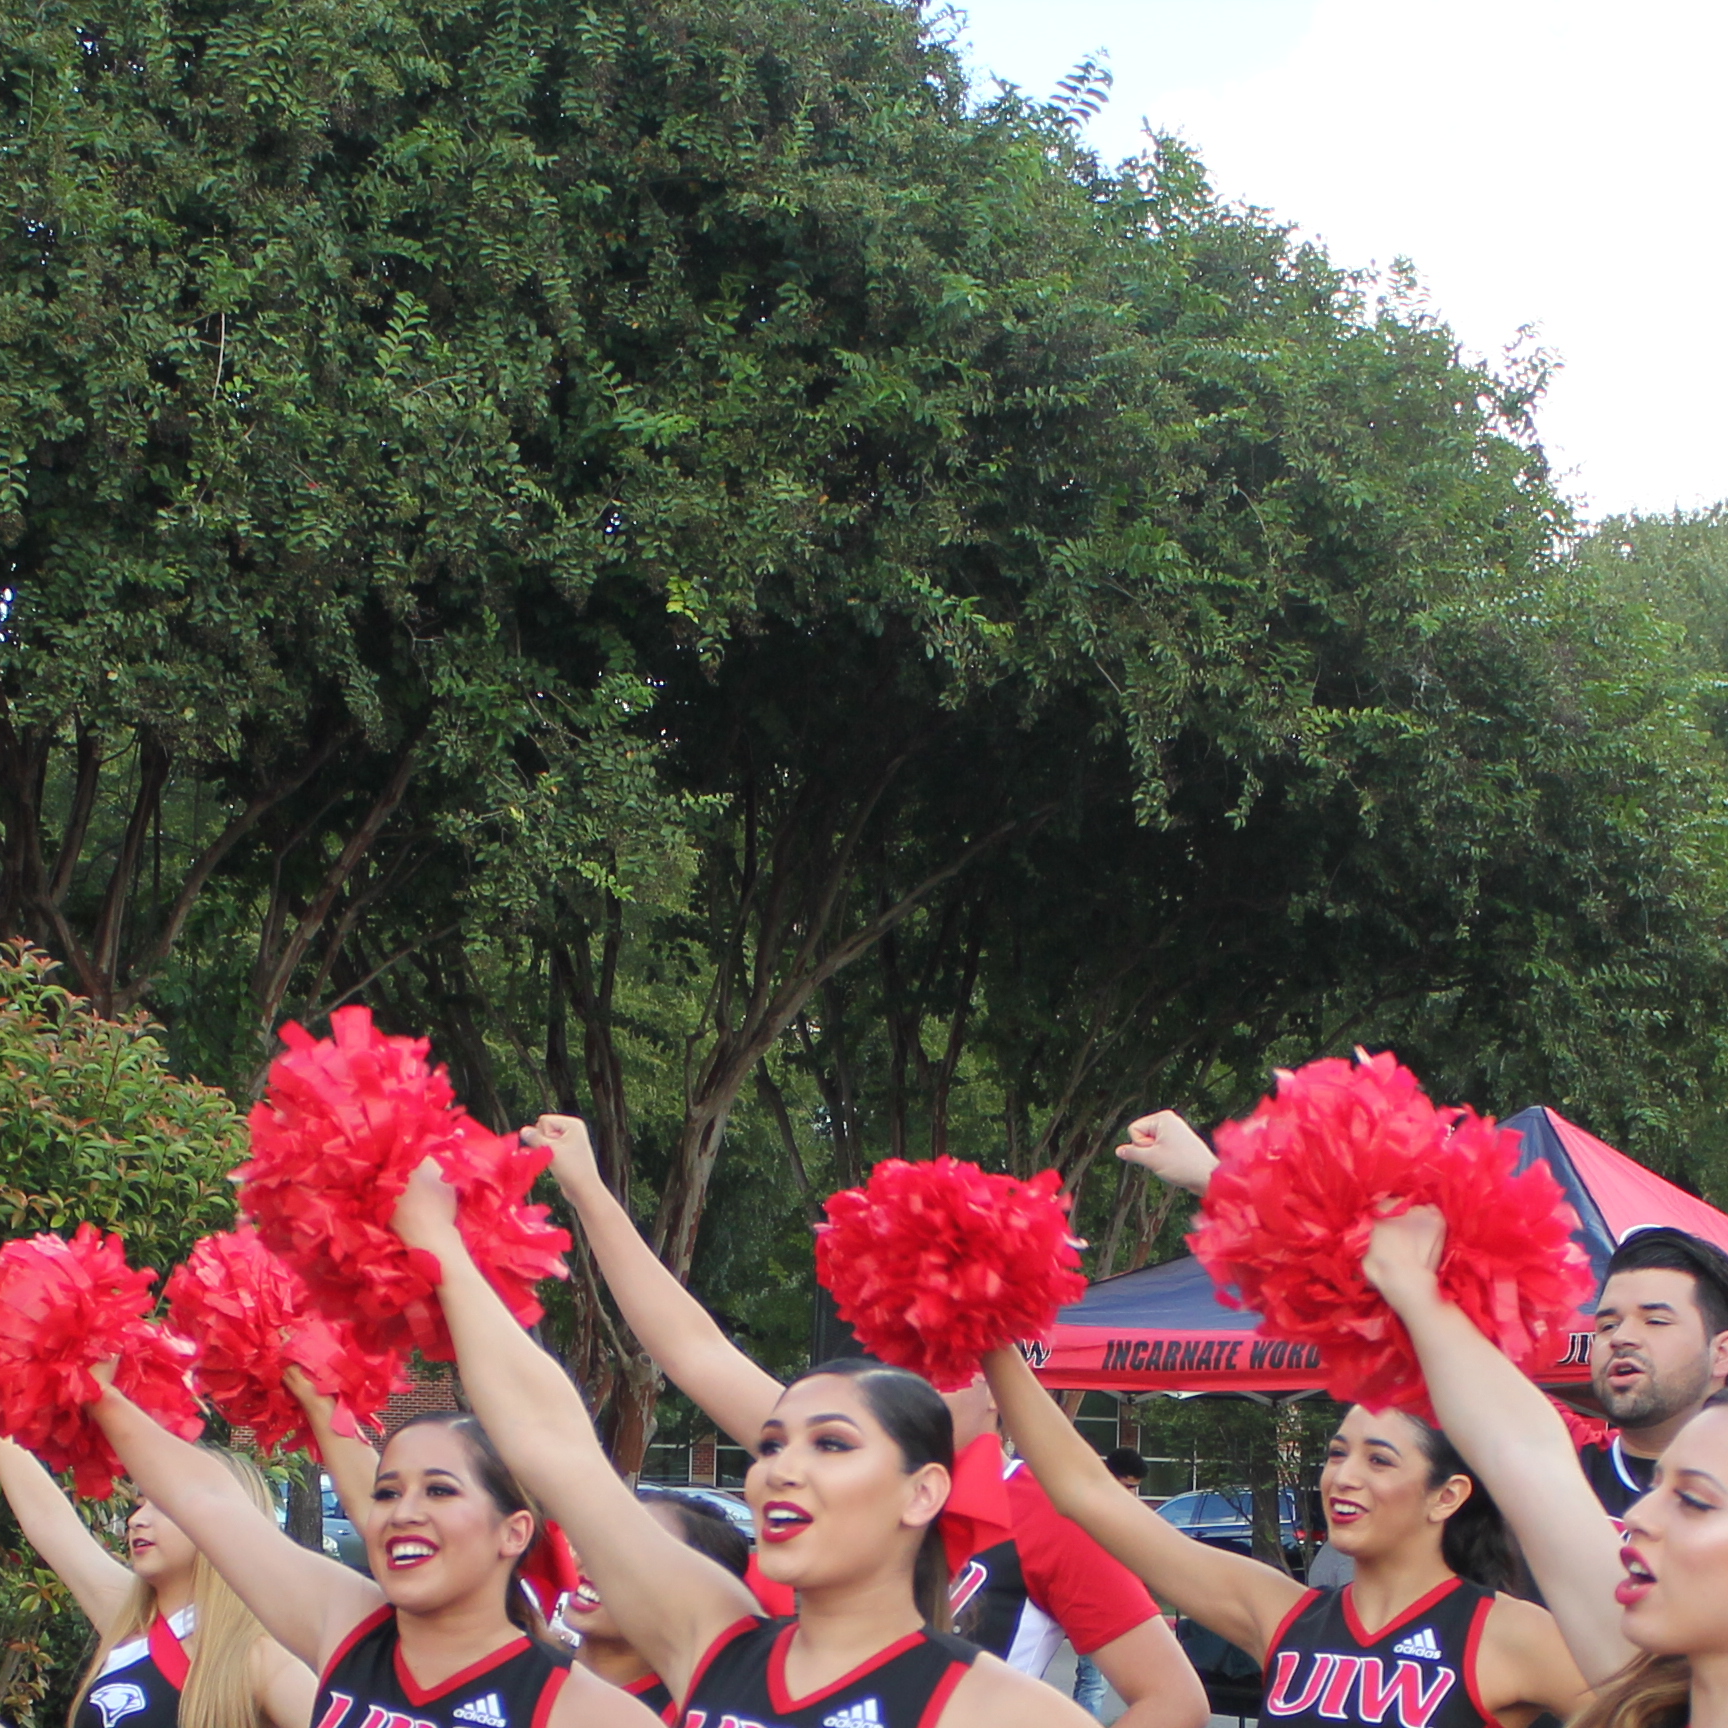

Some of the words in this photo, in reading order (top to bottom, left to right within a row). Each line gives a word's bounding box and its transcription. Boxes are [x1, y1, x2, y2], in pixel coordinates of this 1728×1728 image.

[1102, 1339, 1243, 1371] INCARNATE
[1393, 1643, 1442, 1660] adidas
[453, 1708, 506, 1728] adidas
